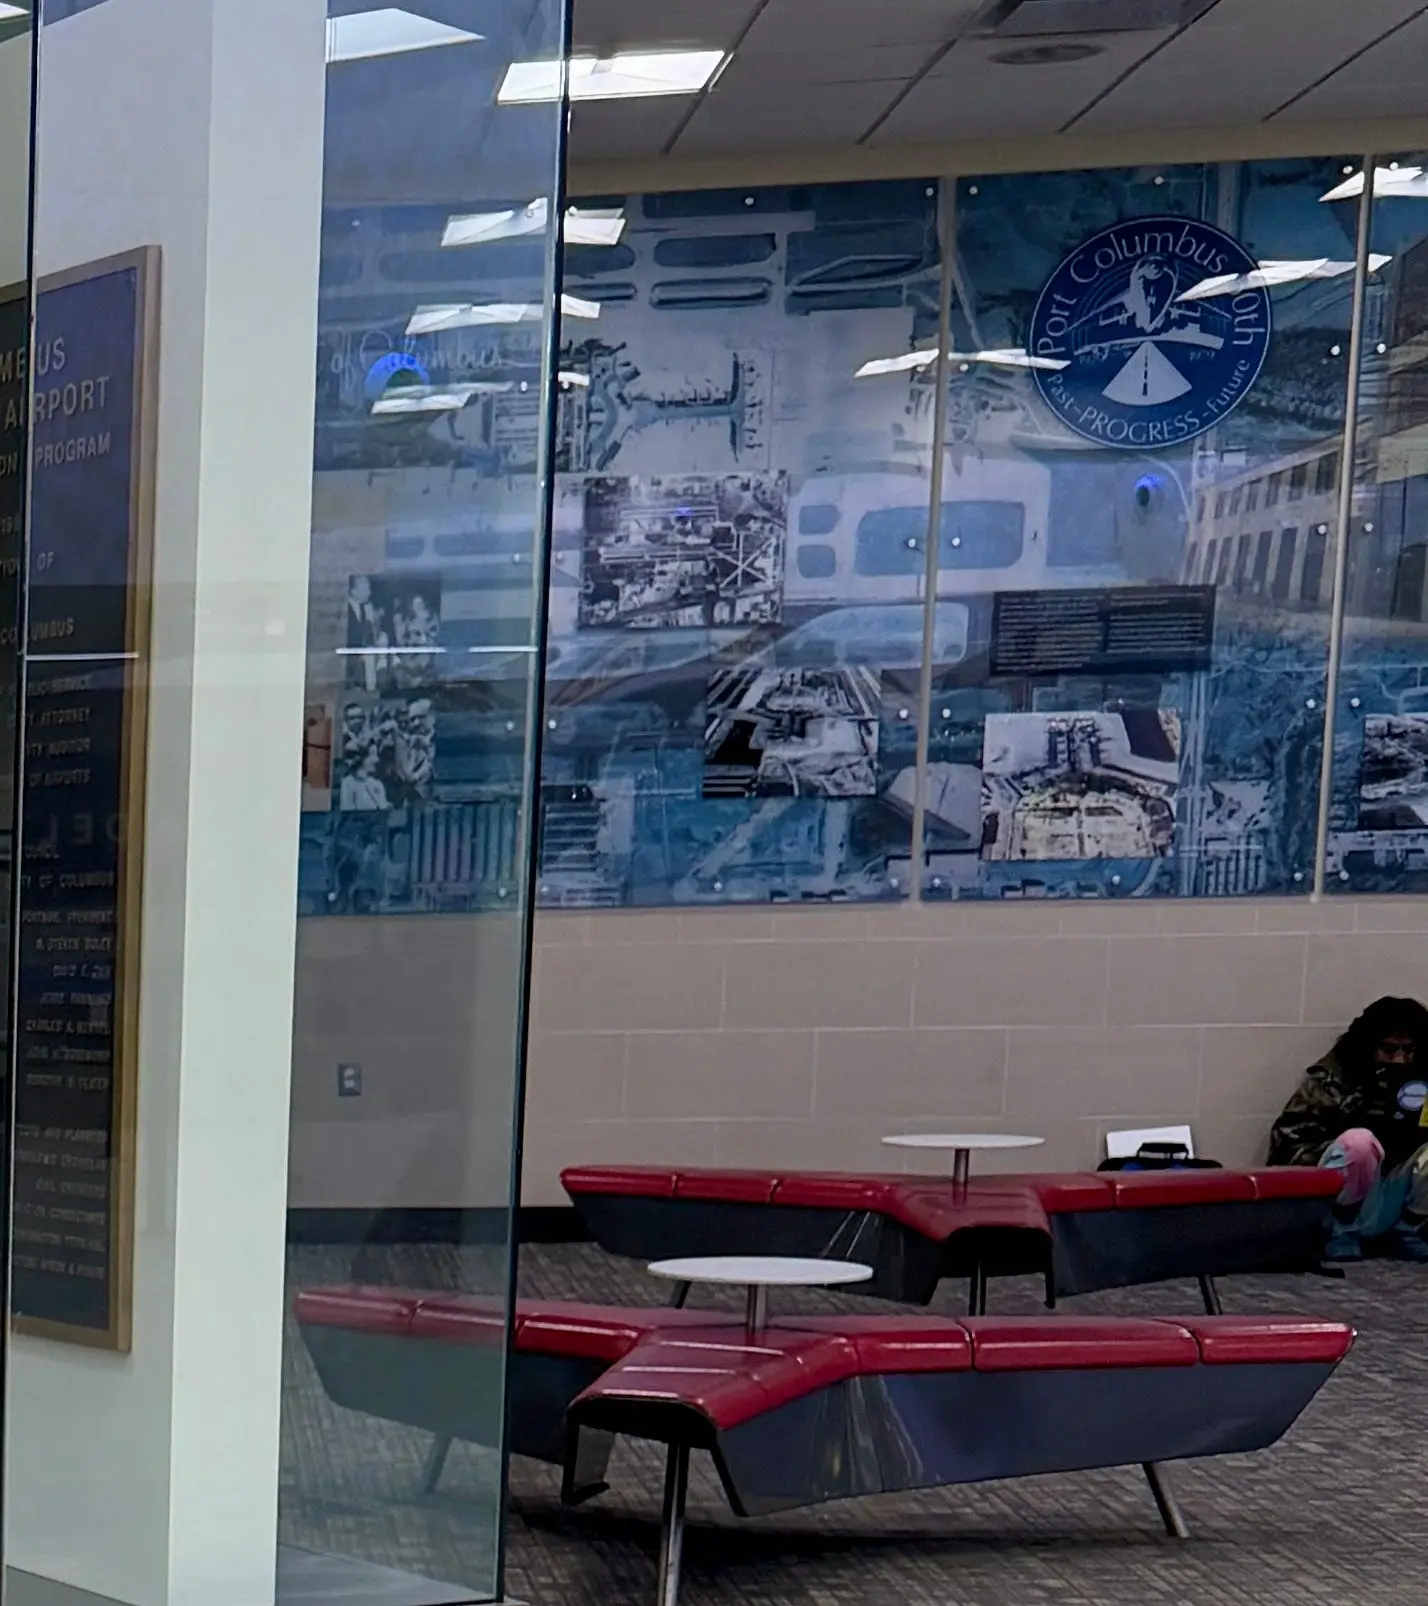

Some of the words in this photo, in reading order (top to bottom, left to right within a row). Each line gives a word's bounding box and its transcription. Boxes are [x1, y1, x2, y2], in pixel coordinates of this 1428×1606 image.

[1036, 293, 1078, 356] Port
[1069, 224, 1229, 284] Columbus
[1228, 288, 1266, 346] 0th
[4, 375, 111, 430] AIRPORT
[34, 431, 112, 468] PROGRAM
[36, 551, 56, 572] OF
[0, 617, 75, 645] COUMBUS
